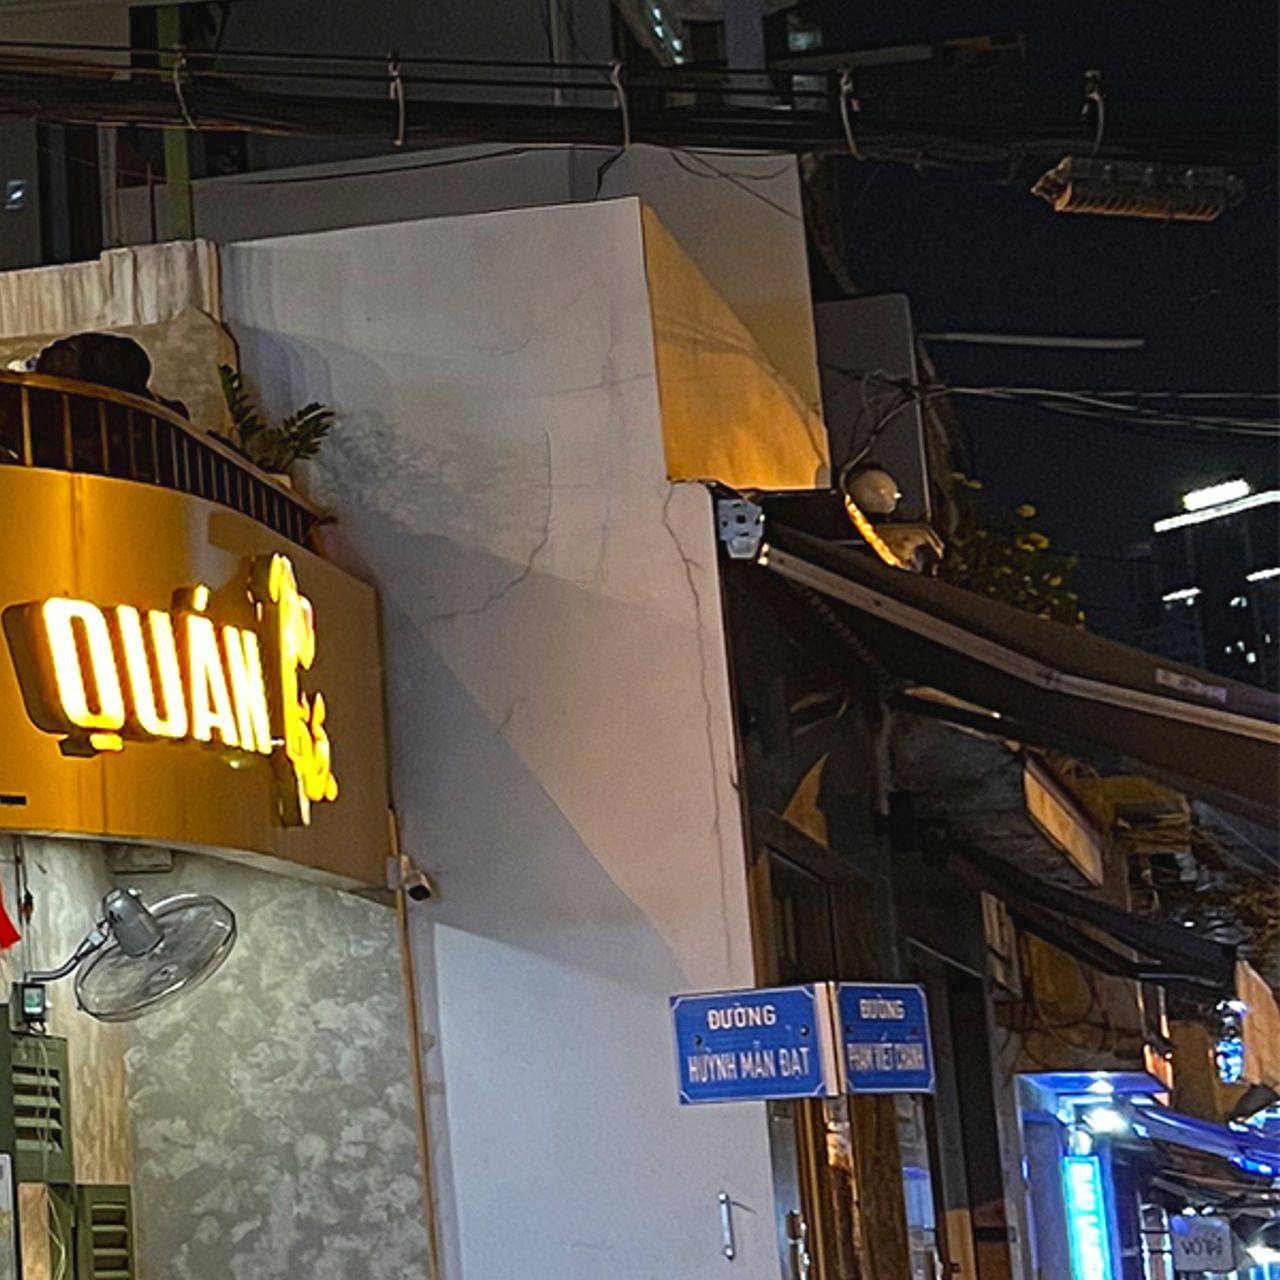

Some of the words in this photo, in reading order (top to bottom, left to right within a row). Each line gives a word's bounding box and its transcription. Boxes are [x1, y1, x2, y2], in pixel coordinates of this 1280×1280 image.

[39, 584, 275, 755] QUÁN
[708, 1002, 777, 1030] ĐƯỜNG
[688, 1046, 738, 1083] HUỲNH
[780, 1047, 811, 1082] ĐẠT
